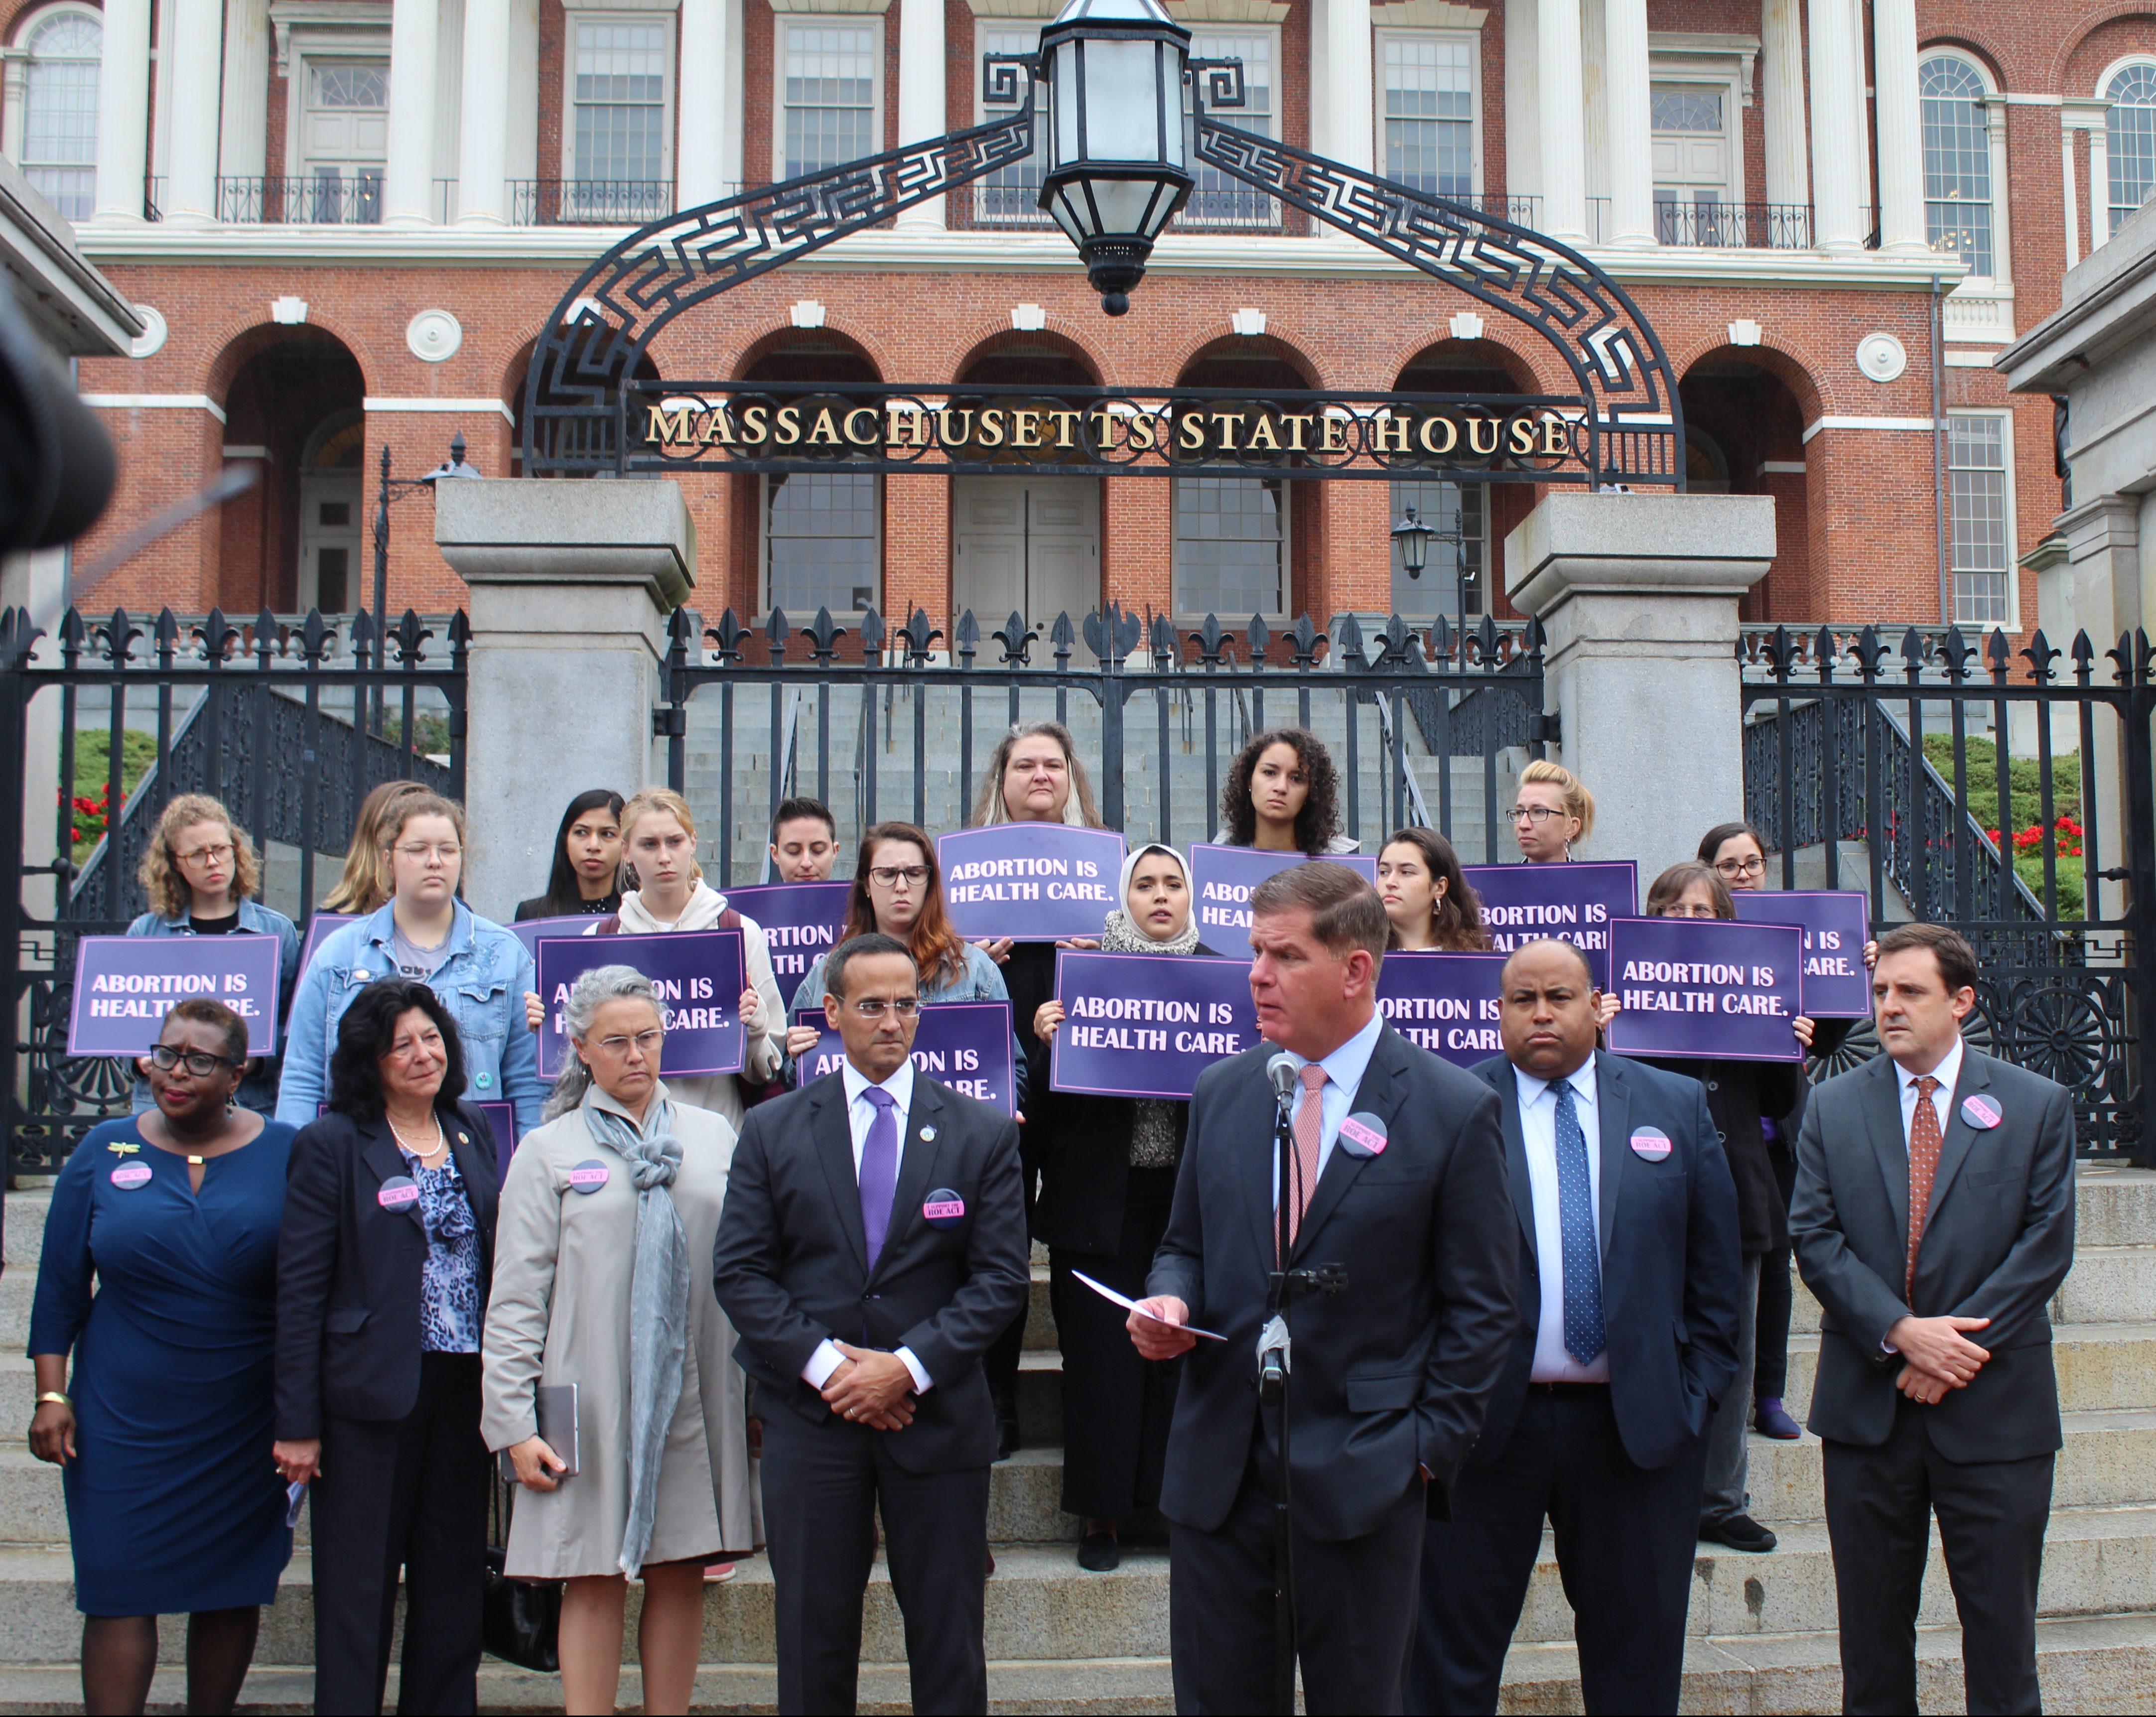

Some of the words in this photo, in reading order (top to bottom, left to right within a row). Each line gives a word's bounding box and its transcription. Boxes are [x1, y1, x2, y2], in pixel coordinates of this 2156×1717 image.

[644, 405, 1155, 450] MASSACHUSETTS
[1179, 411, 1348, 453] STATE
[1372, 416, 1570, 457] HOUSE
[949, 858, 1068, 882] ABORTION
[1076, 860, 1098, 878] IS
[950, 882, 1039, 904] HEALTH
[1047, 882, 1114, 902] CARE.
[1479, 905, 1577, 925] BORTION
[1585, 904, 1607, 923] IS
[762, 925, 833, 947] RTION
[1819, 931, 1841, 950] IS
[92, 974, 217, 993] ABORTION
[224, 973, 248, 993] IS
[1622, 960, 1744, 985] ABORTION
[1752, 966, 1774, 987] IS
[690, 977, 713, 1000] IS
[222, 998, 261, 1017] RE.
[1071, 996, 1200, 1024] ABORTION
[1209, 1002, 1233, 1025] IS
[1377, 998, 1470, 1020] ORTION
[1480, 999, 1501, 1021] IS
[1623, 989, 1714, 1013] HEALTH
[1722, 993, 1789, 1017] CARE.
[1071, 1025, 1167, 1052] HEALTH
[1447, 1028, 1504, 1050] CAR
[954, 1049, 979, 1071] IS
[1343, 1125, 1362, 1139] ROE
[1362, 1136, 1379, 1149] ACT
